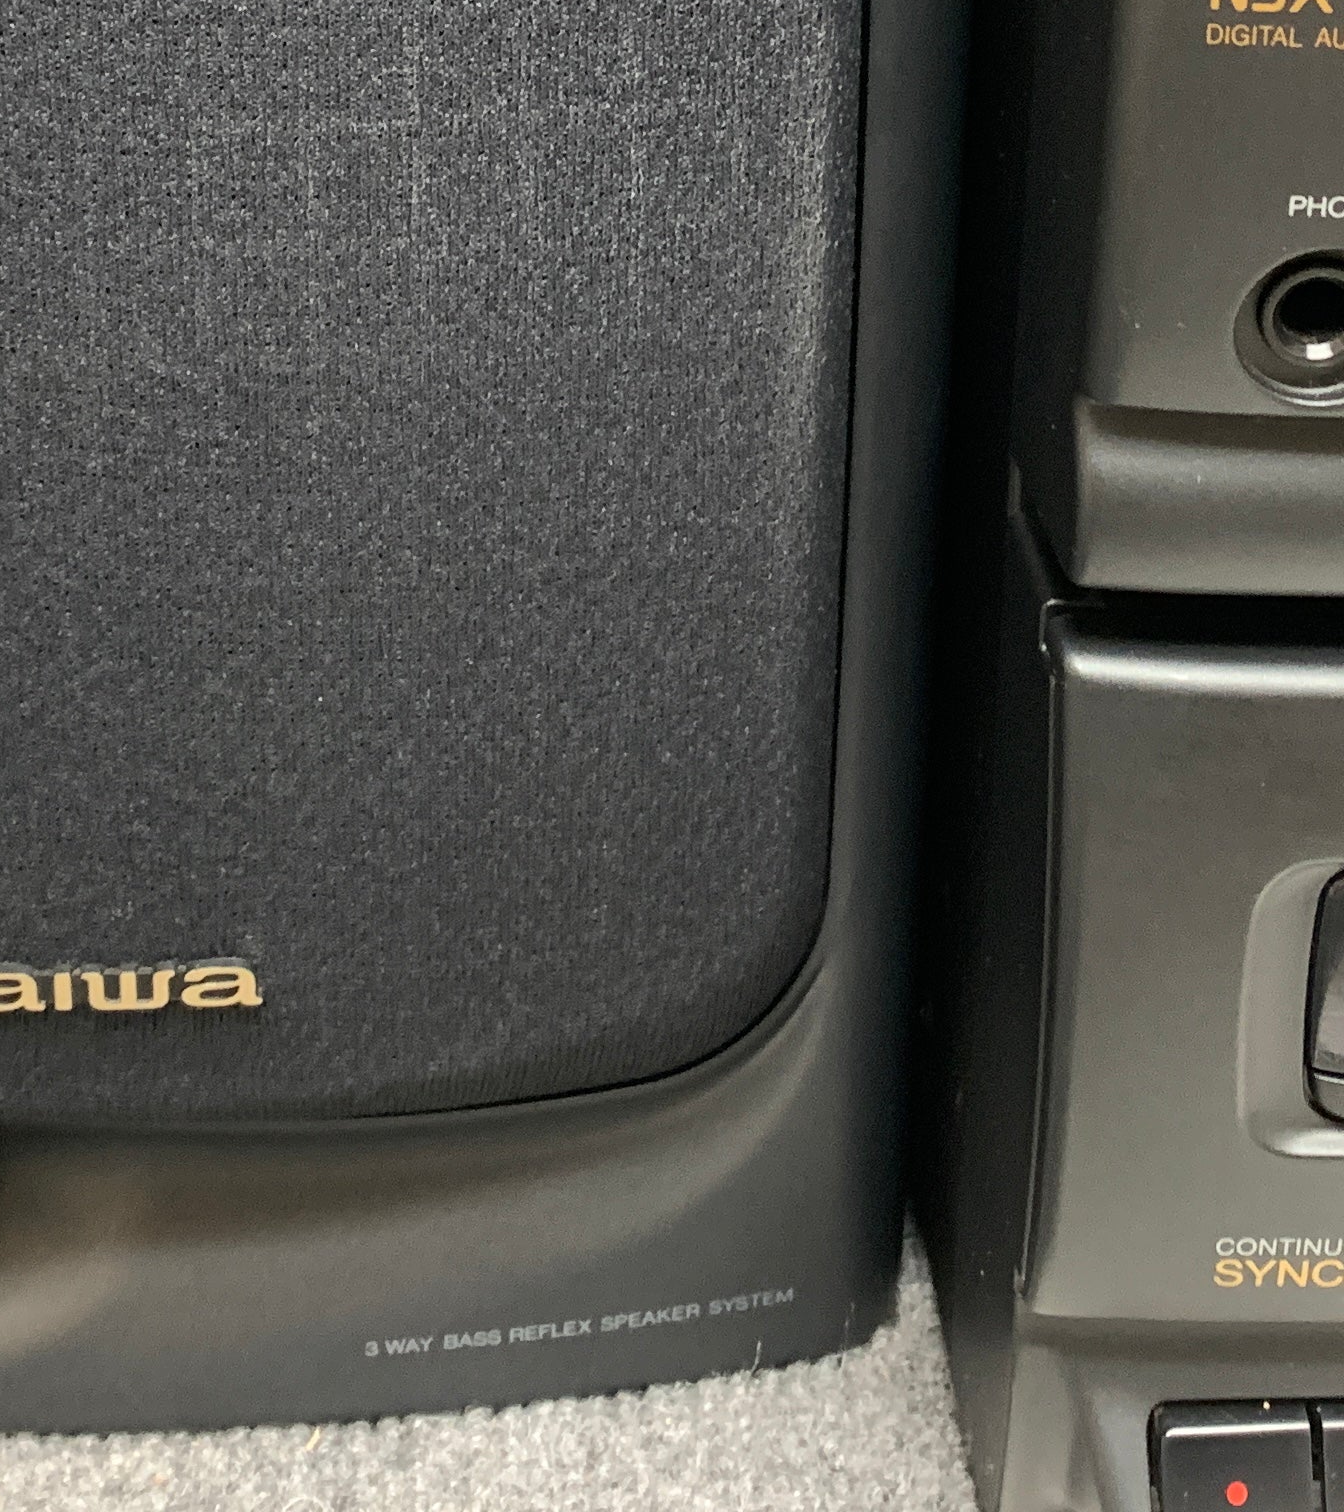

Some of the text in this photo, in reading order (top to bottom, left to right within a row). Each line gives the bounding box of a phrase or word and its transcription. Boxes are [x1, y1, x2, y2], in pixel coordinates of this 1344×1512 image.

[1205, 23, 1303, 48] DIGITAL
[365, 1288, 794, 1357] 3 WAY BASS REFLEX SPEAKER SYSTEM
